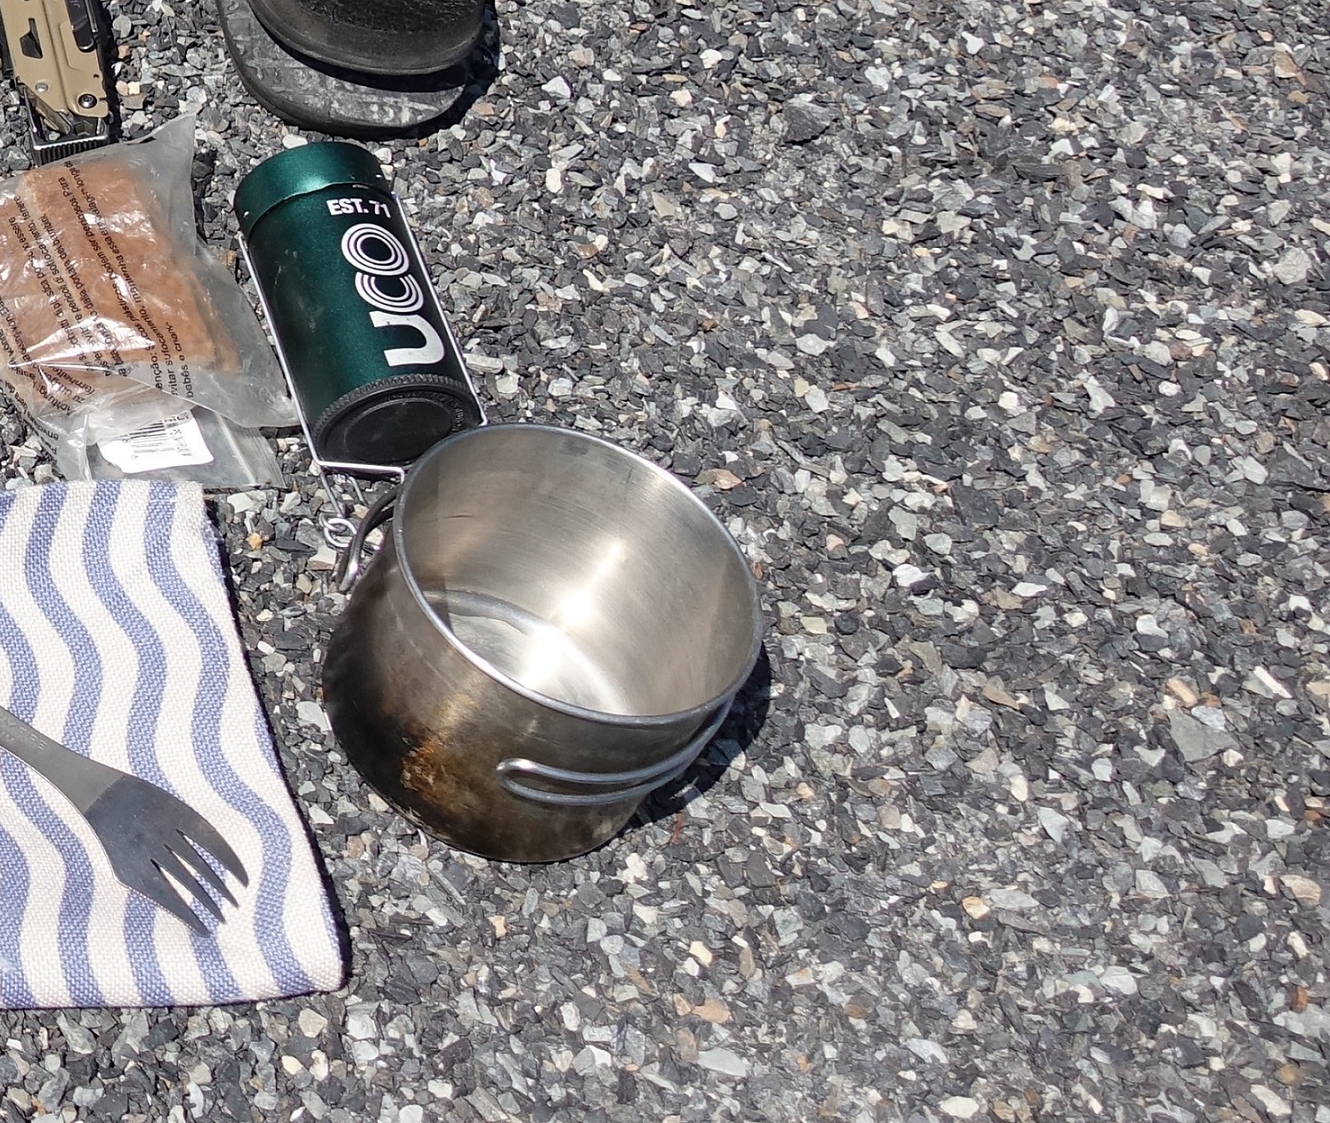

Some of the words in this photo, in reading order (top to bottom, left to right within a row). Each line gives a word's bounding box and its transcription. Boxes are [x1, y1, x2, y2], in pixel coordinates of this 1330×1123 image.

[326, 198, 369, 218] EST.
[370, 199, 392, 220] 71
[340, 223, 449, 368] UCO
